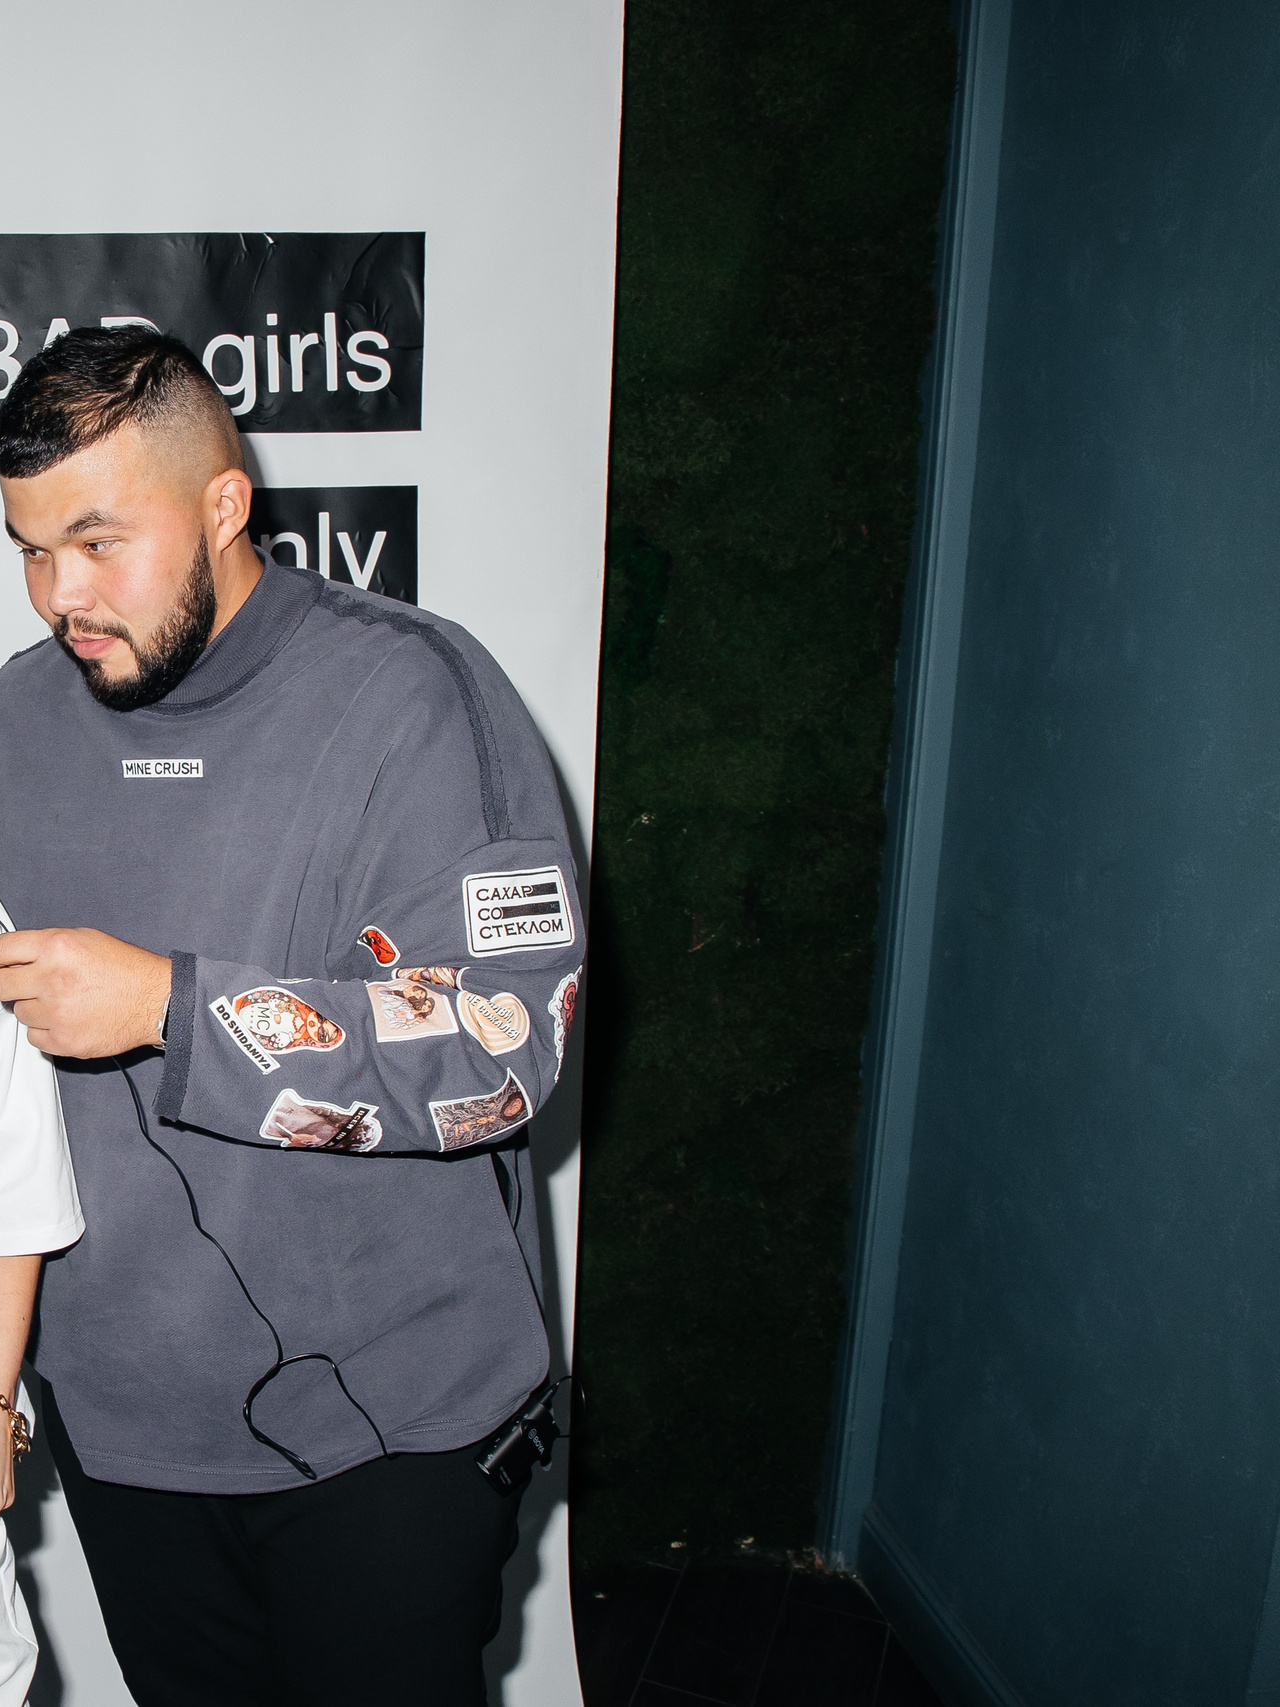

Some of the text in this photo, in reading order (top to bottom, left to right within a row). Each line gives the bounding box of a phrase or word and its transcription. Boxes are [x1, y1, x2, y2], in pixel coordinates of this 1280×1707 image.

[201, 311, 393, 417] girls
[260, 511, 388, 591] nly
[125, 762, 200, 775] MINE CRUSH
[475, 885, 533, 901] САХАР
[477, 906, 503, 921] СО
[479, 918, 564, 939] СТЕКЛОМ
[215, 1004, 272, 1070] DO SVIDANIYA
[532, 1435, 545, 1455] BOYA
